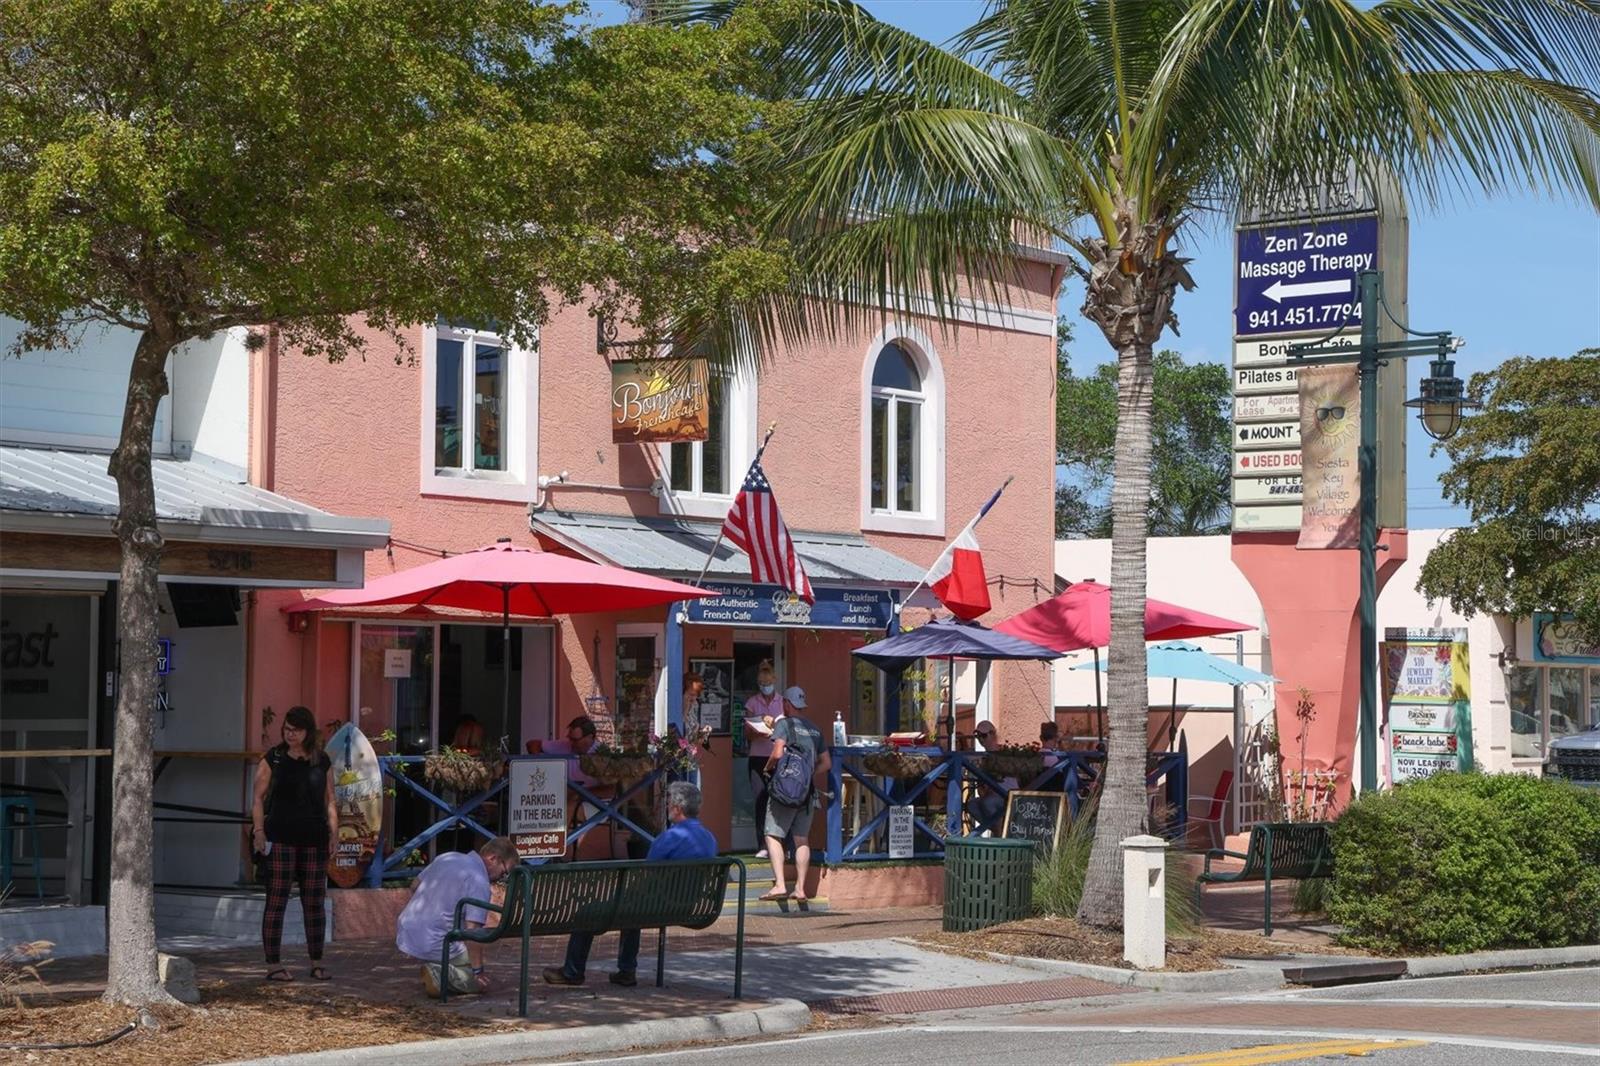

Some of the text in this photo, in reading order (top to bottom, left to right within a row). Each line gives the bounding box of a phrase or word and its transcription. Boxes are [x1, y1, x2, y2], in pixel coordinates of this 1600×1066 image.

[1265, 232, 1348, 253] Zen Zone
[1240, 253, 1373, 278] Massage Therapy
[1248, 303, 1362, 328] 941.451.7794
[1239, 370, 1282, 385] Pilates
[613, 382, 704, 424] Bonjour
[1243, 399, 1260, 407] For
[1237, 406, 1265, 416] Lease
[1251, 426, 1293, 439] MOUNT
[1253, 455, 1281, 467] USED
[1316, 457, 1349, 470] Siesta
[1257, 477, 1279, 485] FOR
[1323, 475, 1344, 487] Key
[1316, 487, 1350, 504] Village
[732, 586, 755, 598] Key's
[843, 592, 878, 602] Breakfast
[699, 598, 759, 608] Most Authentic
[849, 604, 872, 613] Lunch
[703, 610, 752, 620] French Cafe
[842, 615, 877, 624] and More
[1406, 667, 1433, 676] JEWELRY
[1407, 677, 1432, 685] MARKET
[1397, 759, 1415, 767] NOW
[520, 793, 556, 806] PARKING
[513, 808, 562, 821] IN THE REAR
[516, 834, 559, 846] Bonjour Cafe
[336, 858, 357, 867] LUNCH
